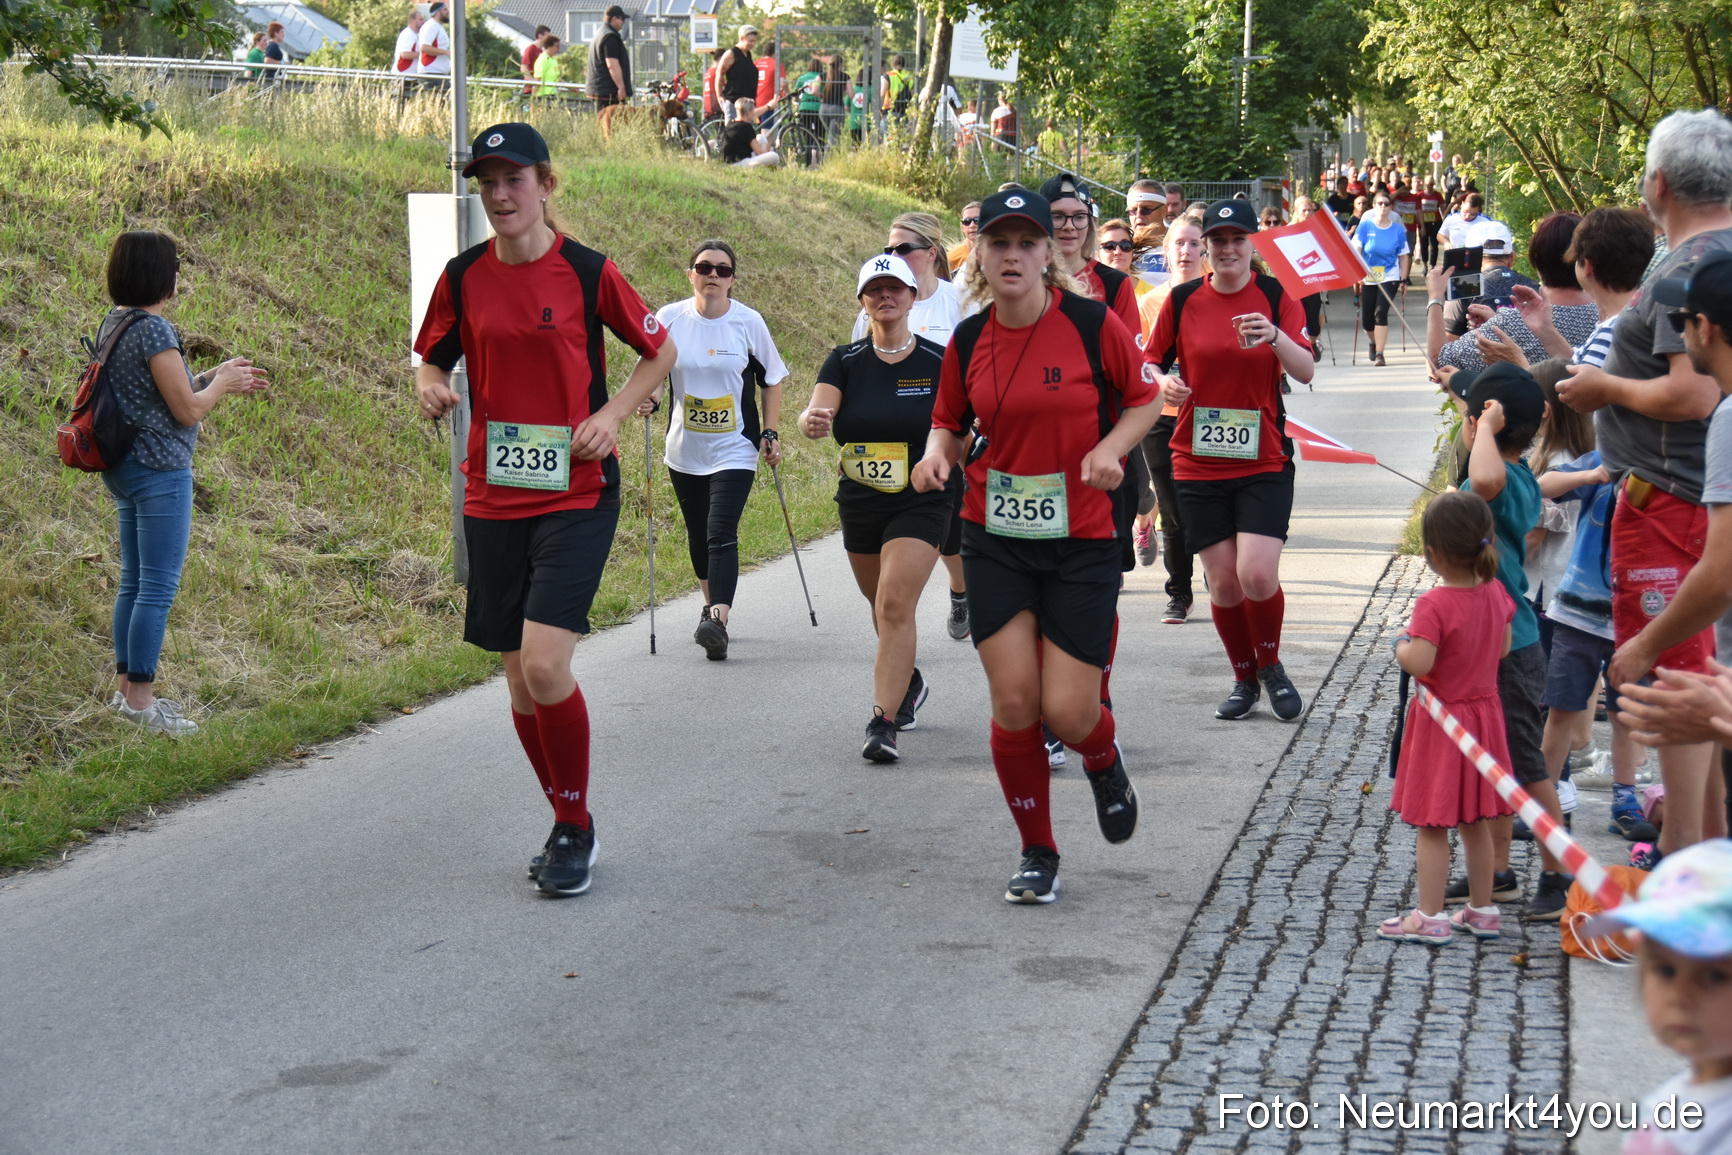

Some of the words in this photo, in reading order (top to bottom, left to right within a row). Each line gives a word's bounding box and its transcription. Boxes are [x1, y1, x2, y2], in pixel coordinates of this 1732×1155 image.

[542, 307, 552, 322] 8
[1043, 367, 1061, 384] 18
[689, 408, 729, 424] 2382
[1200, 425, 1250, 445] 2330
[496, 445, 557, 471] 2338
[525, 470, 549, 478] Sabrina
[855, 460, 892, 479] 132
[993, 494, 1055, 521] 2356
